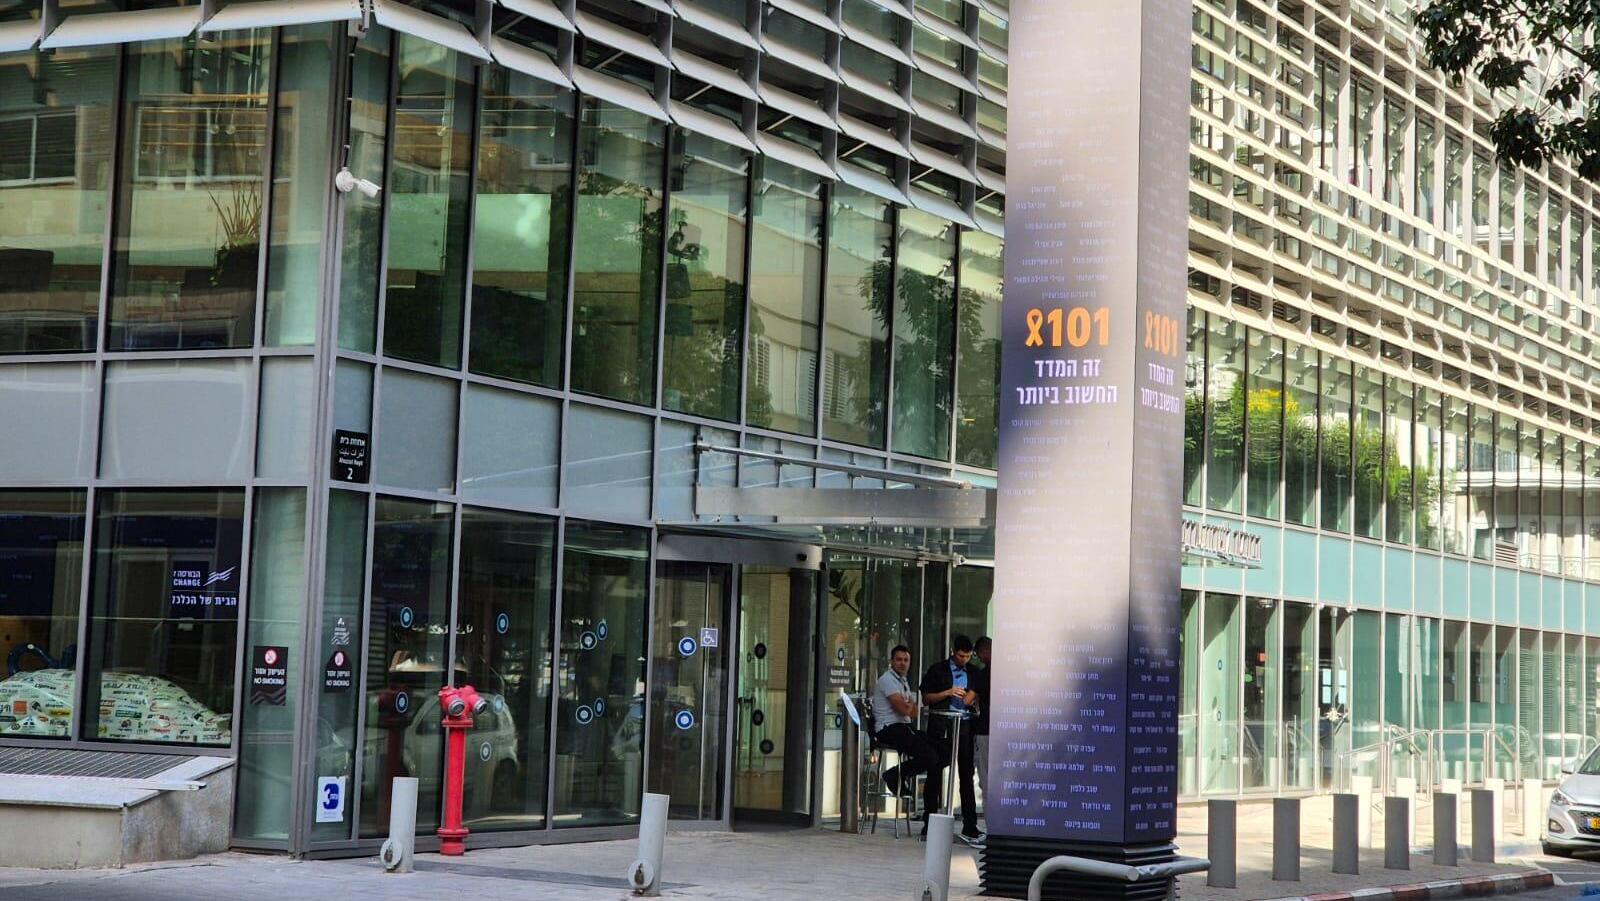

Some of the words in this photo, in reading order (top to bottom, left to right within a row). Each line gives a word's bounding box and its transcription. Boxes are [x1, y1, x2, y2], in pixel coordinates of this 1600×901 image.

[1047, 307, 1110, 348] 101
[1153, 313, 1178, 358] 101
[1034, 359, 1078, 378] המדד
[1083, 359, 1101, 377] זה
[1148, 362, 1166, 385] המדד
[1166, 367, 1174, 386] זה
[1016, 386, 1060, 405] ביותר
[1064, 385, 1118, 405] החשוב
[1141, 387, 1159, 409] ביותר
[1159, 392, 1180, 414] החשוב
[347, 467, 353, 480] 2
[173, 578, 201, 587] CHANGE
[199, 594, 212, 605] של
[214, 596, 237, 606] הבית
